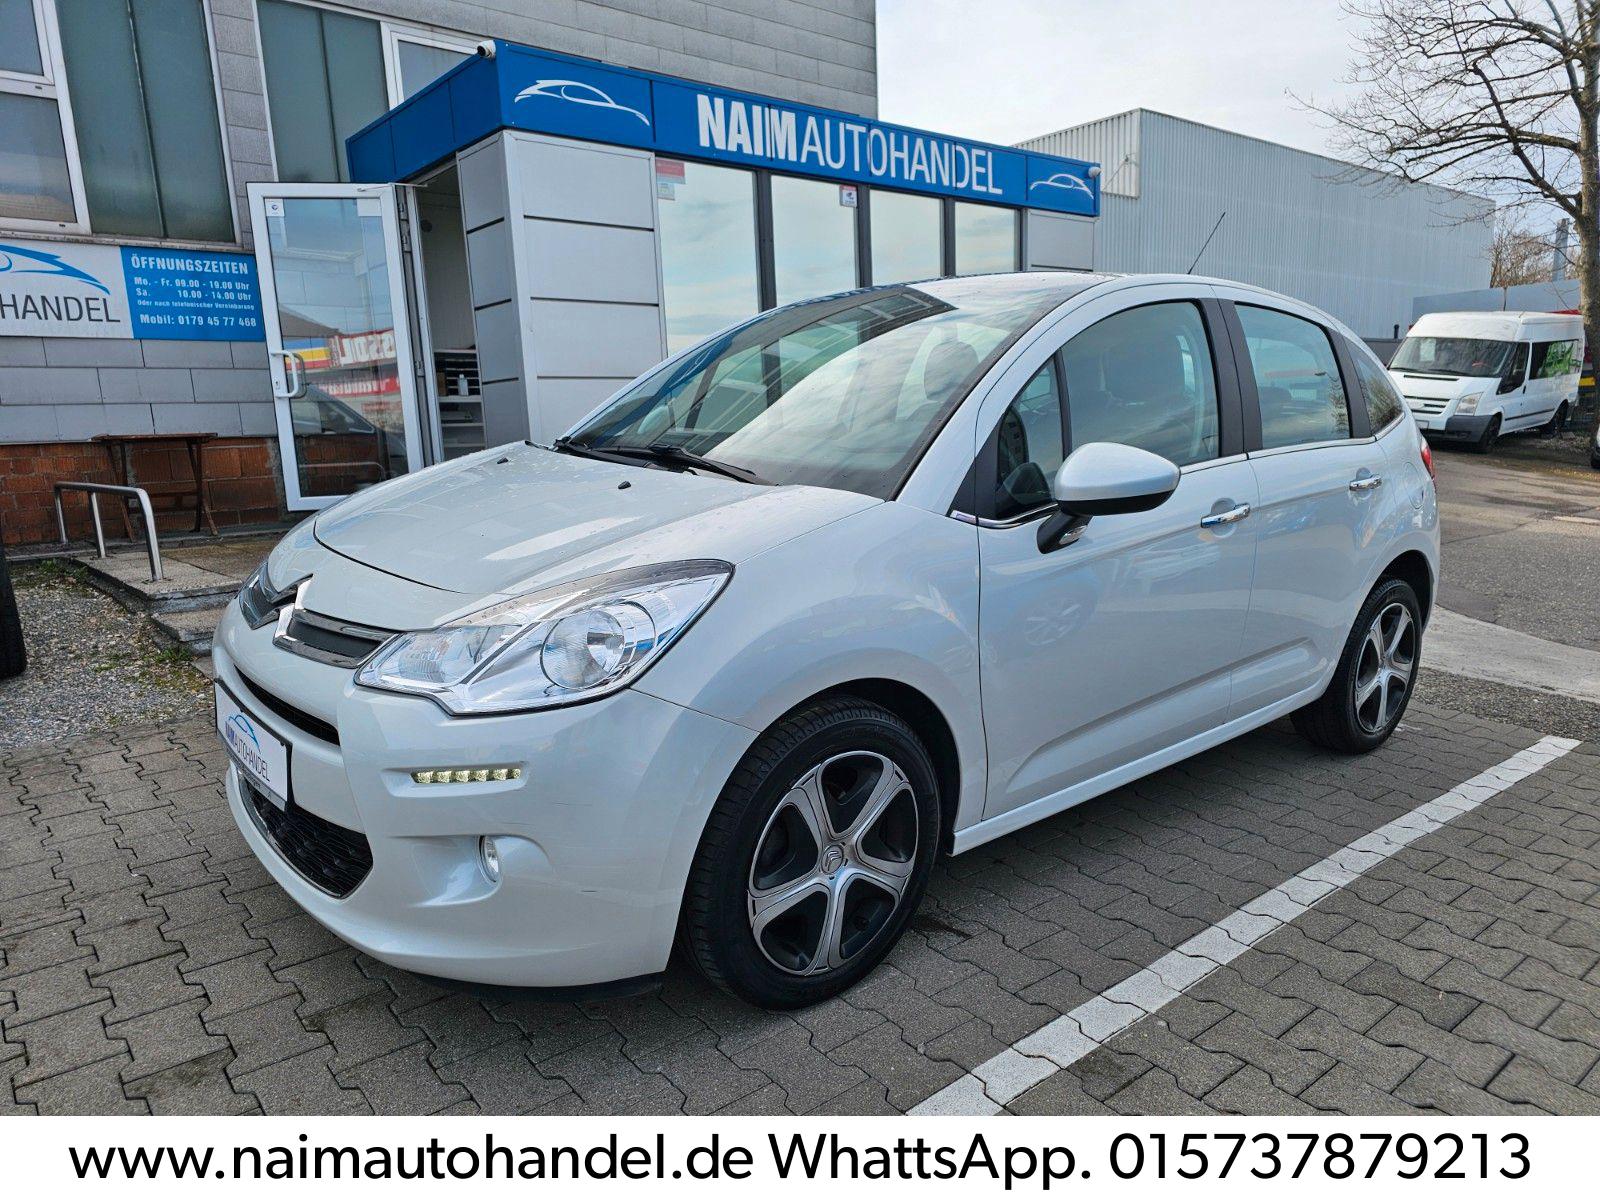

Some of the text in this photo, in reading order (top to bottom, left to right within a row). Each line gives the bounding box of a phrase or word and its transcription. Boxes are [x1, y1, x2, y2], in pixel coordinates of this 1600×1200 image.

[697, 94, 1003, 195] NAIM AUTOHANDEL
[131, 253, 249, 275] ÖFFNUNGSZEITEN
[134, 277, 152, 287] Mo.
[161, 278, 173, 287] Fr.
[175, 279, 200, 288] 09.00
[209, 280, 233, 289] 19.00
[235, 282, 250, 290] Uhr
[136, 288, 151, 297] Sa.
[178, 290, 202, 299] 10.00
[211, 292, 235, 300] 14.00
[237, 293, 252, 301] Uhr
[0, 293, 121, 323] HANDEL
[172, 301, 213, 309] telefonischer
[215, 303, 255, 311] Vereinbarung
[140, 314, 257, 328] Mobil: 0179 45 77 468
